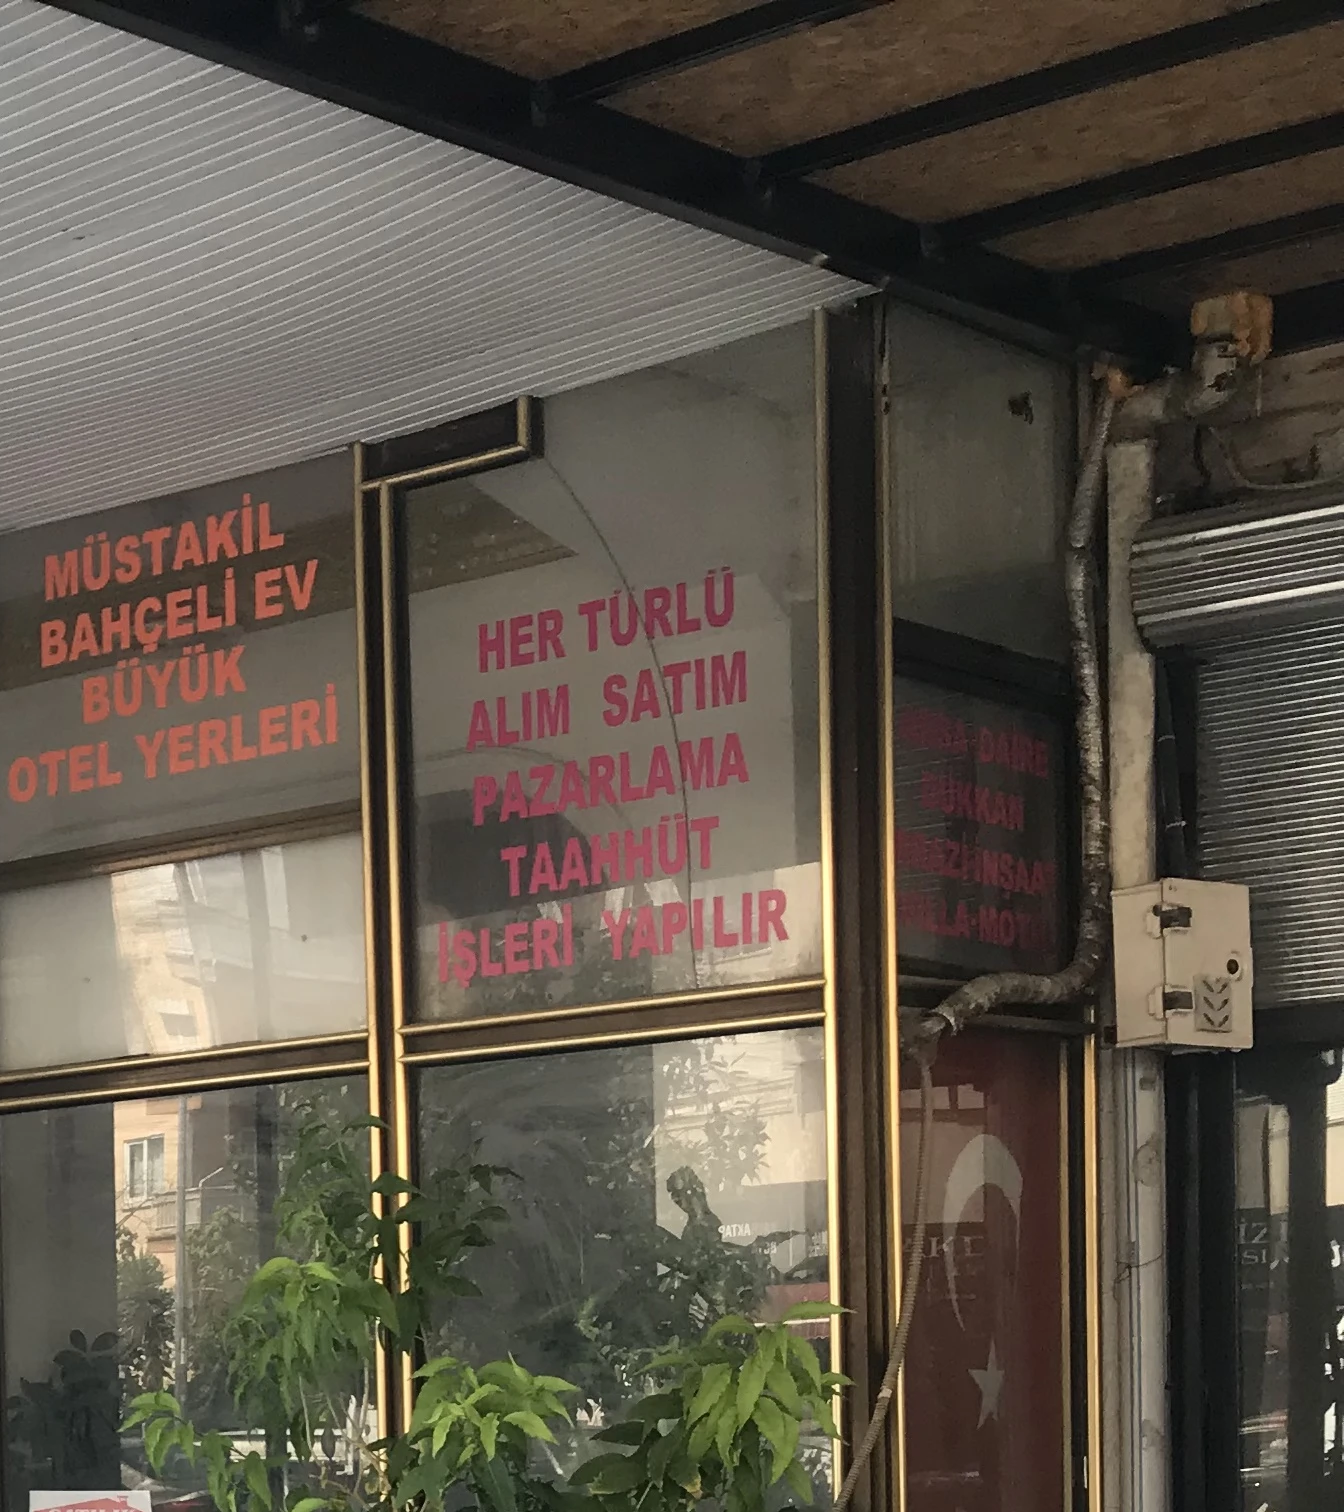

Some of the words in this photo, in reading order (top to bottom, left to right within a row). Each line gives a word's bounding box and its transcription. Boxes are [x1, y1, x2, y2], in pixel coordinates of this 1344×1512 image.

[43, 493, 285, 601] MÜSTAKİL
[40, 567, 236, 668] BAHÇELİ
[254, 559, 319, 620] EV
[478, 608, 566, 673] HER
[579, 566, 735, 652] TÜRLÜ
[82, 645, 246, 724] BÜYÜK
[466, 684, 570, 752] ALIM
[603, 650, 747, 727] SATIM
[7, 741, 122, 803] OTEL
[135, 683, 338, 779] YERLERİ
[472, 732, 750, 827] PAZARLAMA
[500, 814, 720, 897] TAAHHÜT
[438, 903, 574, 989] İŞLERİ
[602, 888, 789, 961] YAPILIR
